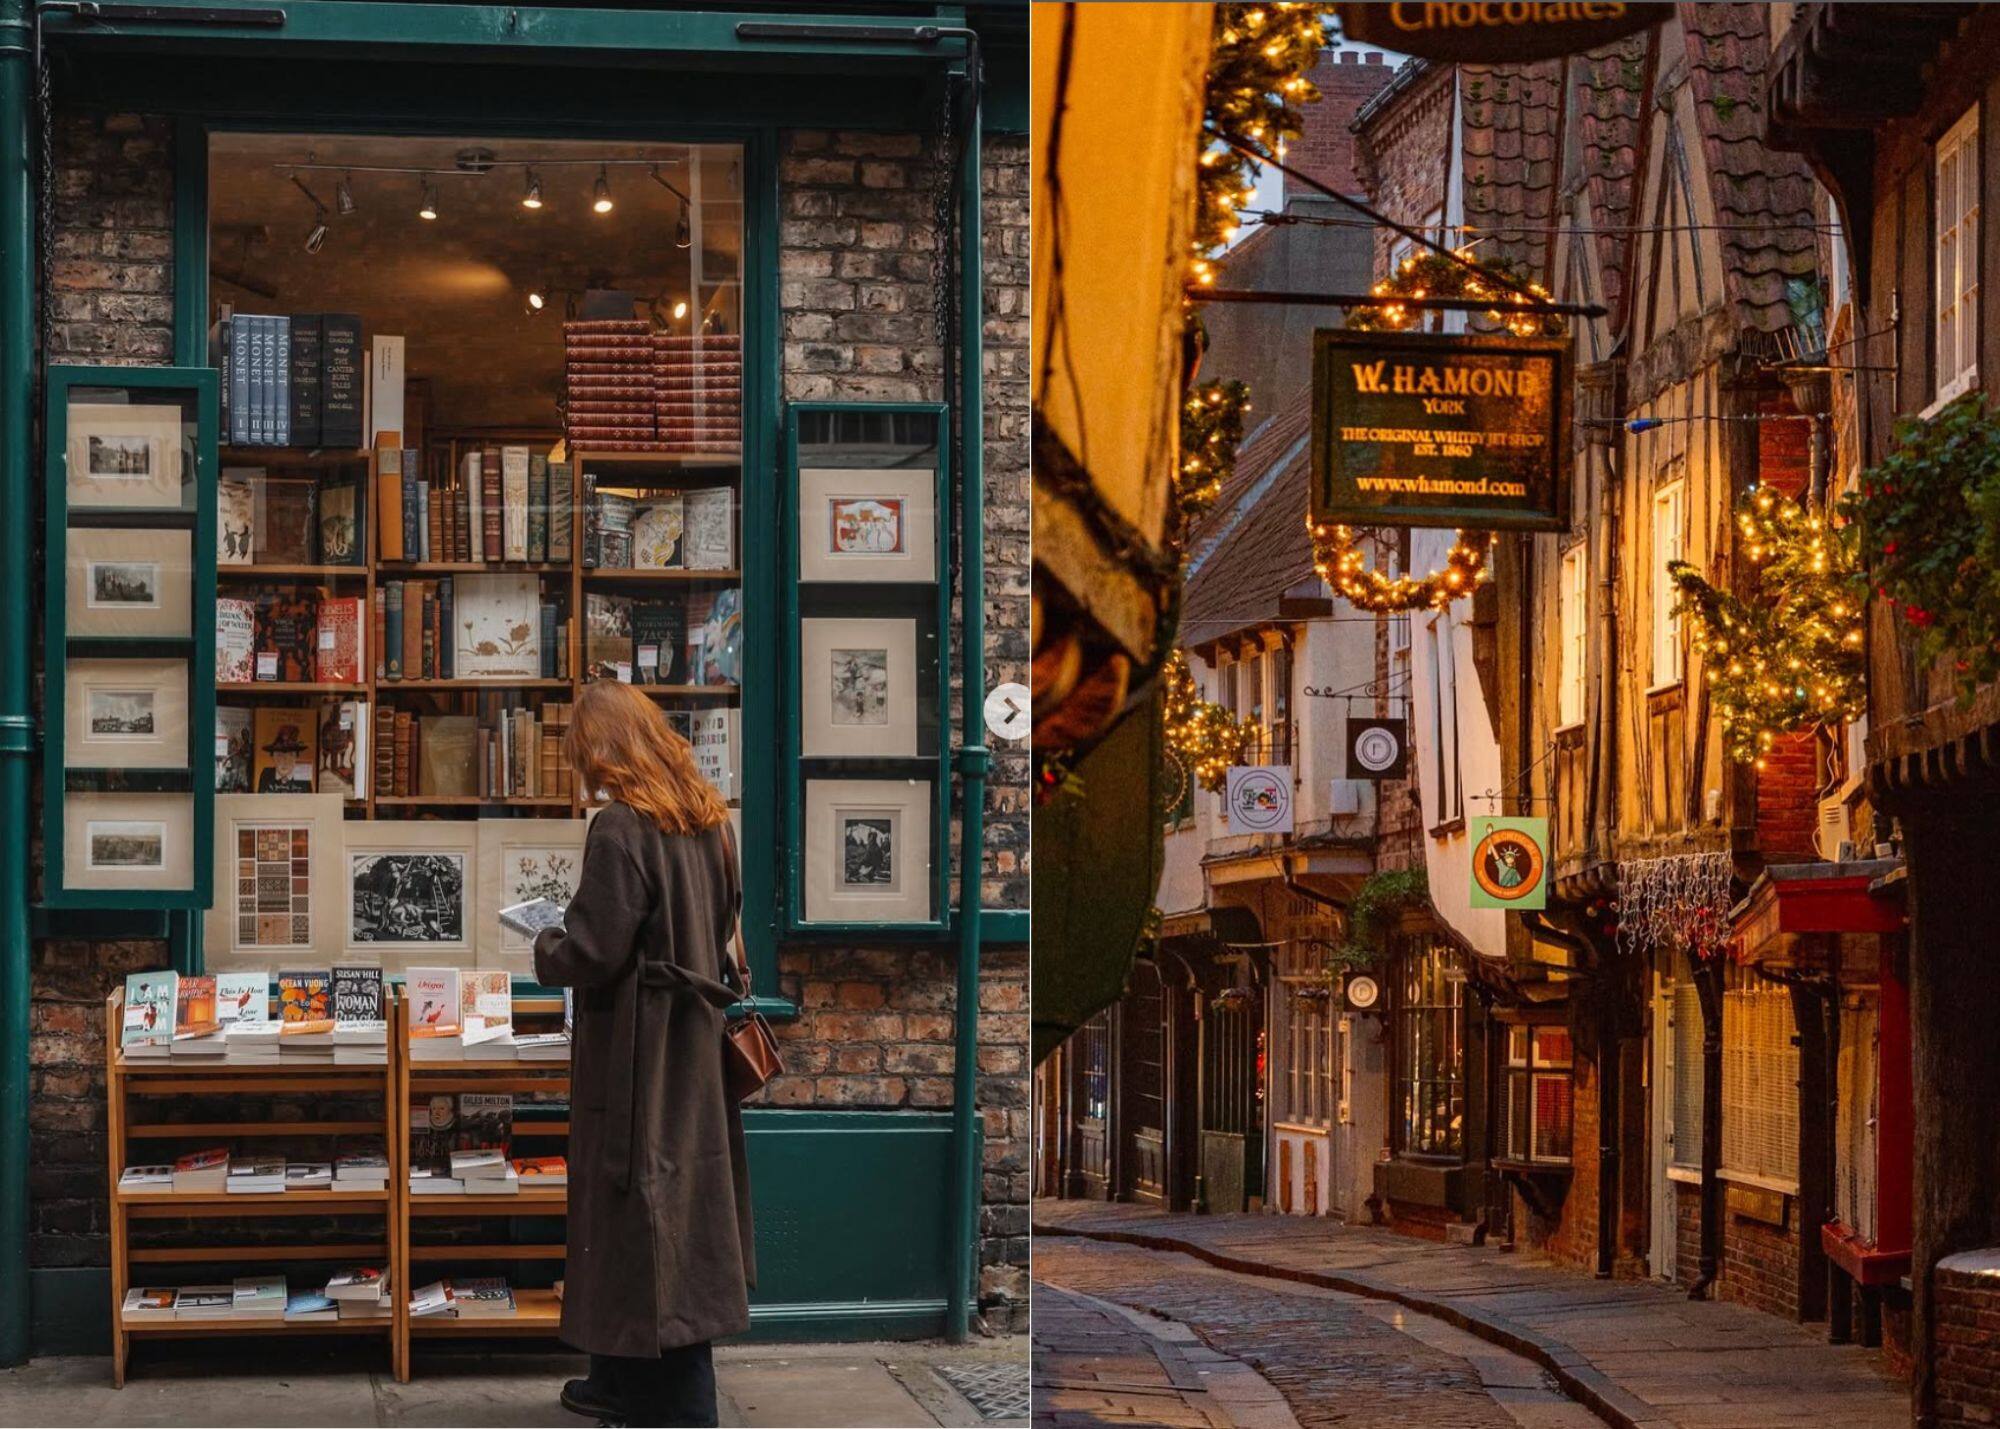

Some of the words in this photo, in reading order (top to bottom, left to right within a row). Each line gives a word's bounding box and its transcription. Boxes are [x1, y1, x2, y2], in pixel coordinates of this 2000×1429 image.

[235, 332, 247, 384] MONET
[251, 333, 262, 386] MONET
[264, 334, 274, 386] MONET
[278, 335, 288, 386] MONET
[1352, 360, 1389, 393] W.
[1392, 365, 1540, 397] HAMOND
[1423, 398, 1465, 415] YORK
[1341, 427, 1368, 441] THE
[1368, 427, 1433, 443] ORIGINAL
[1433, 430, 1484, 444] WHITBY
[1486, 432, 1508, 446] JET
[1508, 433, 1545, 446] SHOP
[1413, 444, 1439, 456] EST.
[1442, 444, 1473, 457] 1860
[1356, 475, 1526, 496] www.whamond.com
[304, 979, 330, 988] VUONG
[335, 969, 360, 979] SUSAN
[361, 969, 380, 980] HILL
[335, 992, 378, 1013] WOMAN
[463, 1095, 482, 1105] GILES
[484, 1095, 510, 1105] MILTON
